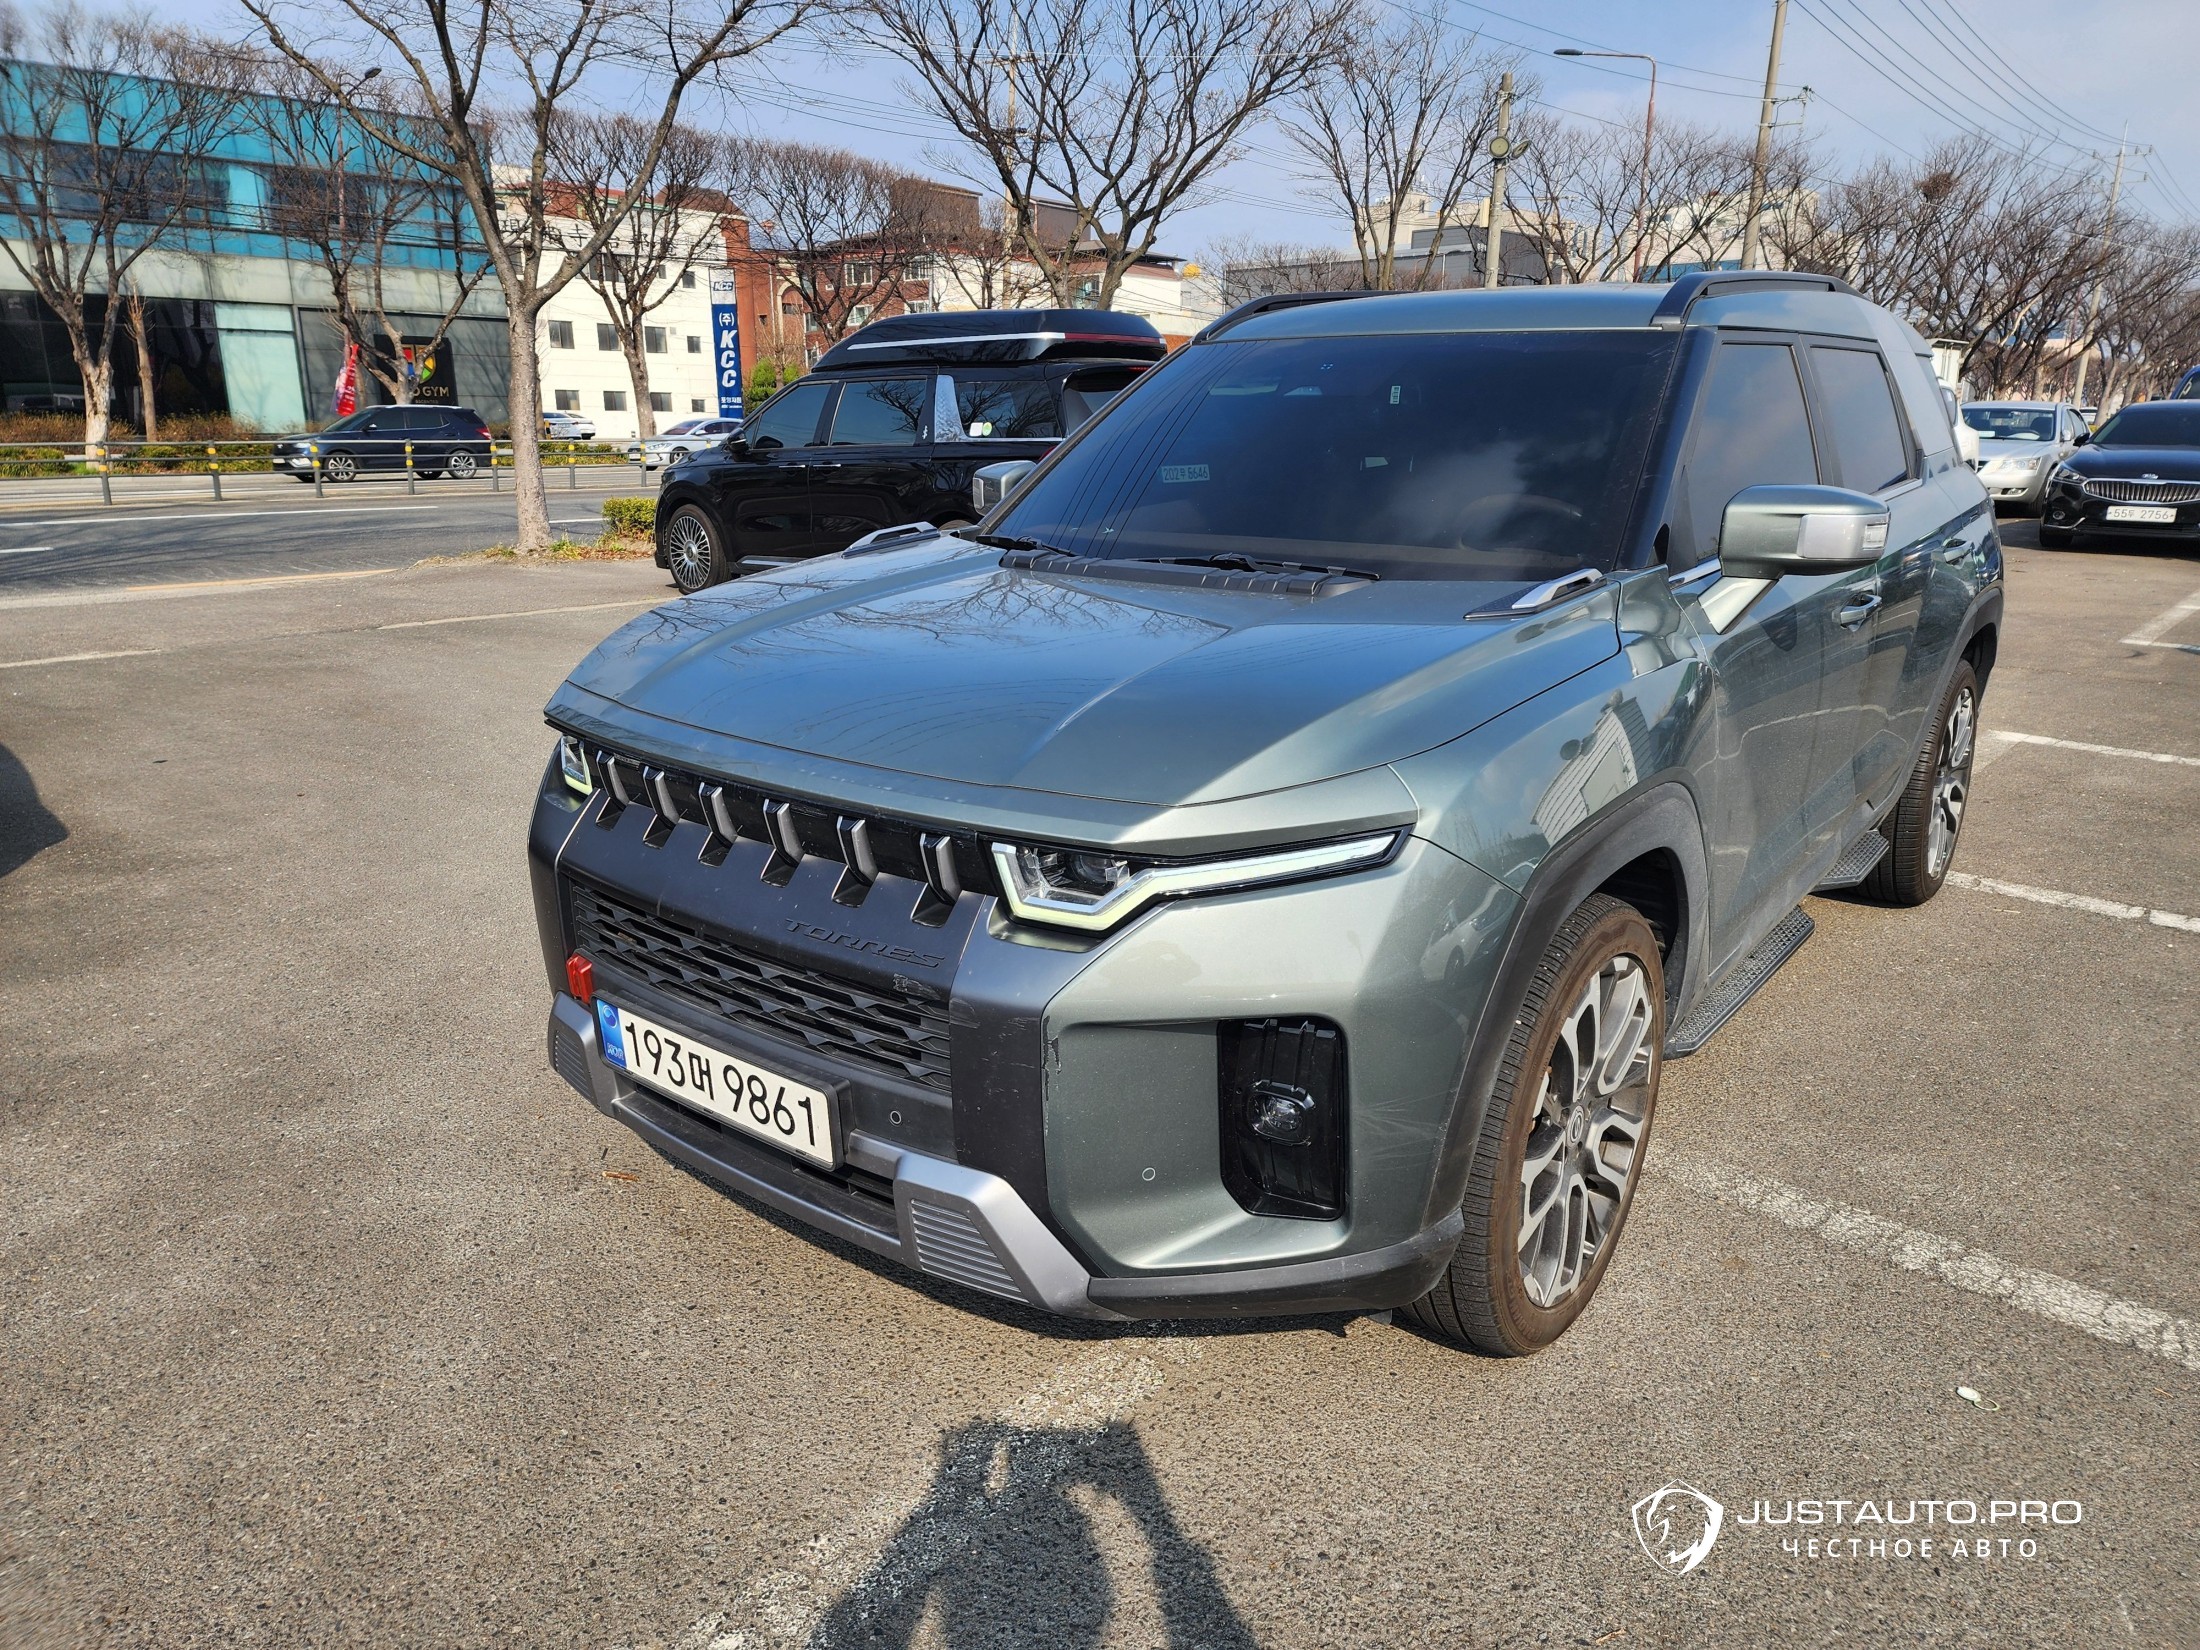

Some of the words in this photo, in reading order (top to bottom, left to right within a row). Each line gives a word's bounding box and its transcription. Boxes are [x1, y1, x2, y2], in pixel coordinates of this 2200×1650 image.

[714, 281, 733, 291] KCC
[719, 312, 735, 327] (주)
[720, 329, 737, 388] KCC
[422, 386, 450, 397] GYM
[2140, 509, 2169, 520] 2756
[785, 918, 945, 968] TORRES
[607, 1042, 624, 1061] KOR
[625, 1022, 715, 1101] 193머
[723, 1064, 816, 1146] 9861
